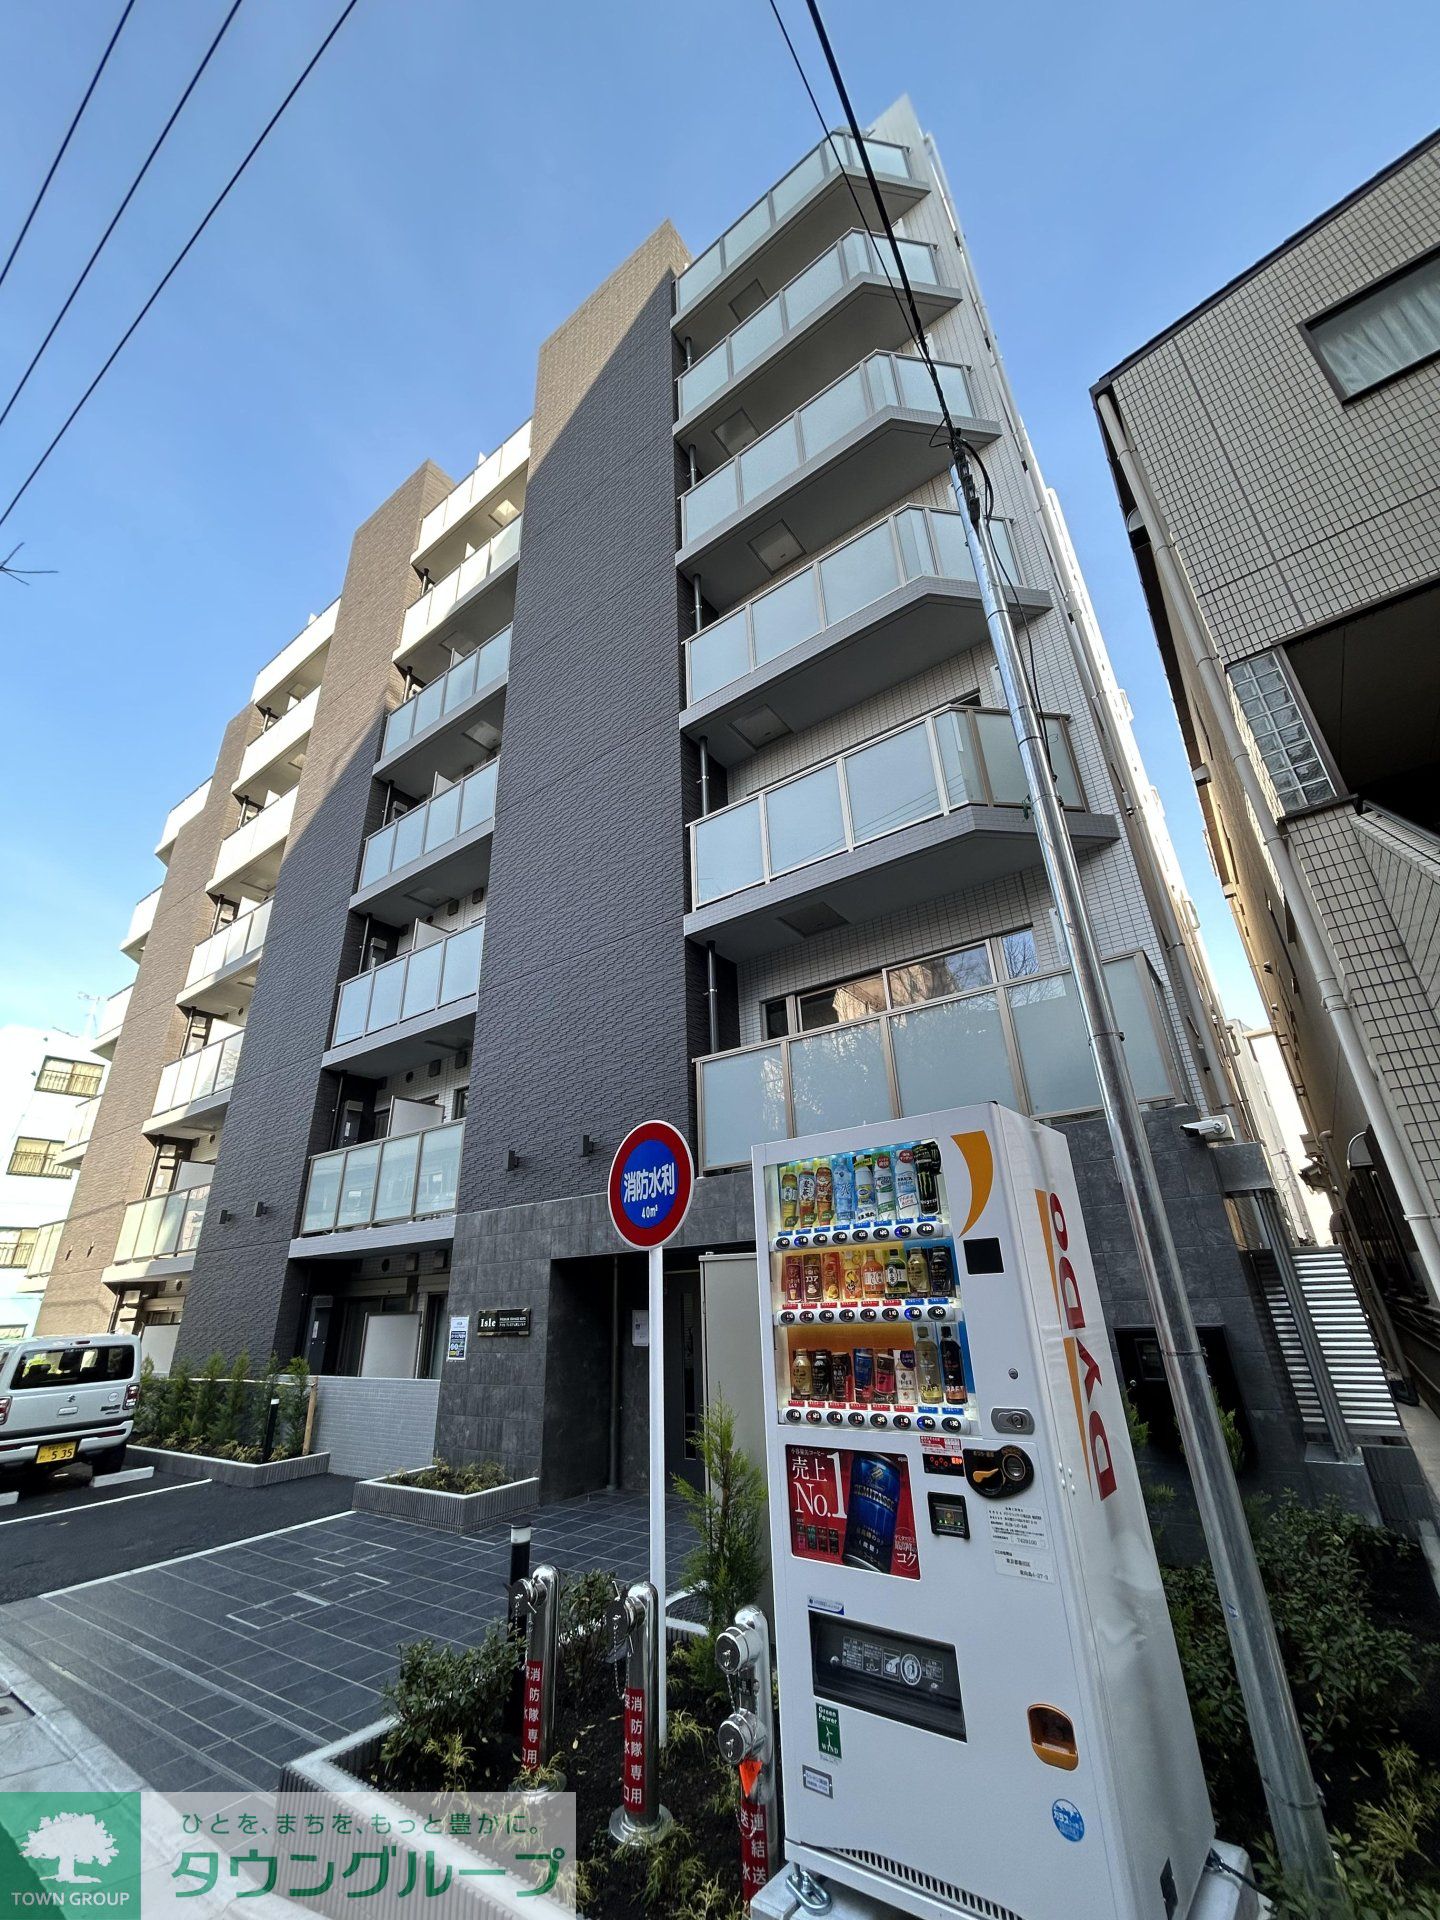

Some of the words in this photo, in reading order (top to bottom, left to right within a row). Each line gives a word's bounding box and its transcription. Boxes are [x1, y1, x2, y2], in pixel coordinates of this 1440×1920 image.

[623, 1162, 675, 1203] 消防水利
[480, 1317, 497, 1328] Isle
[792, 1456, 828, 1482] 売上
[793, 1451, 848, 1519] No.1
[896, 1552, 917, 1567] コク
[527, 1667, 541, 1764] 消防隊専用
[818, 1705, 837, 1717] Green
[818, 1712, 838, 1725] Power
[630, 1696, 643, 1805] 消防隊専用
